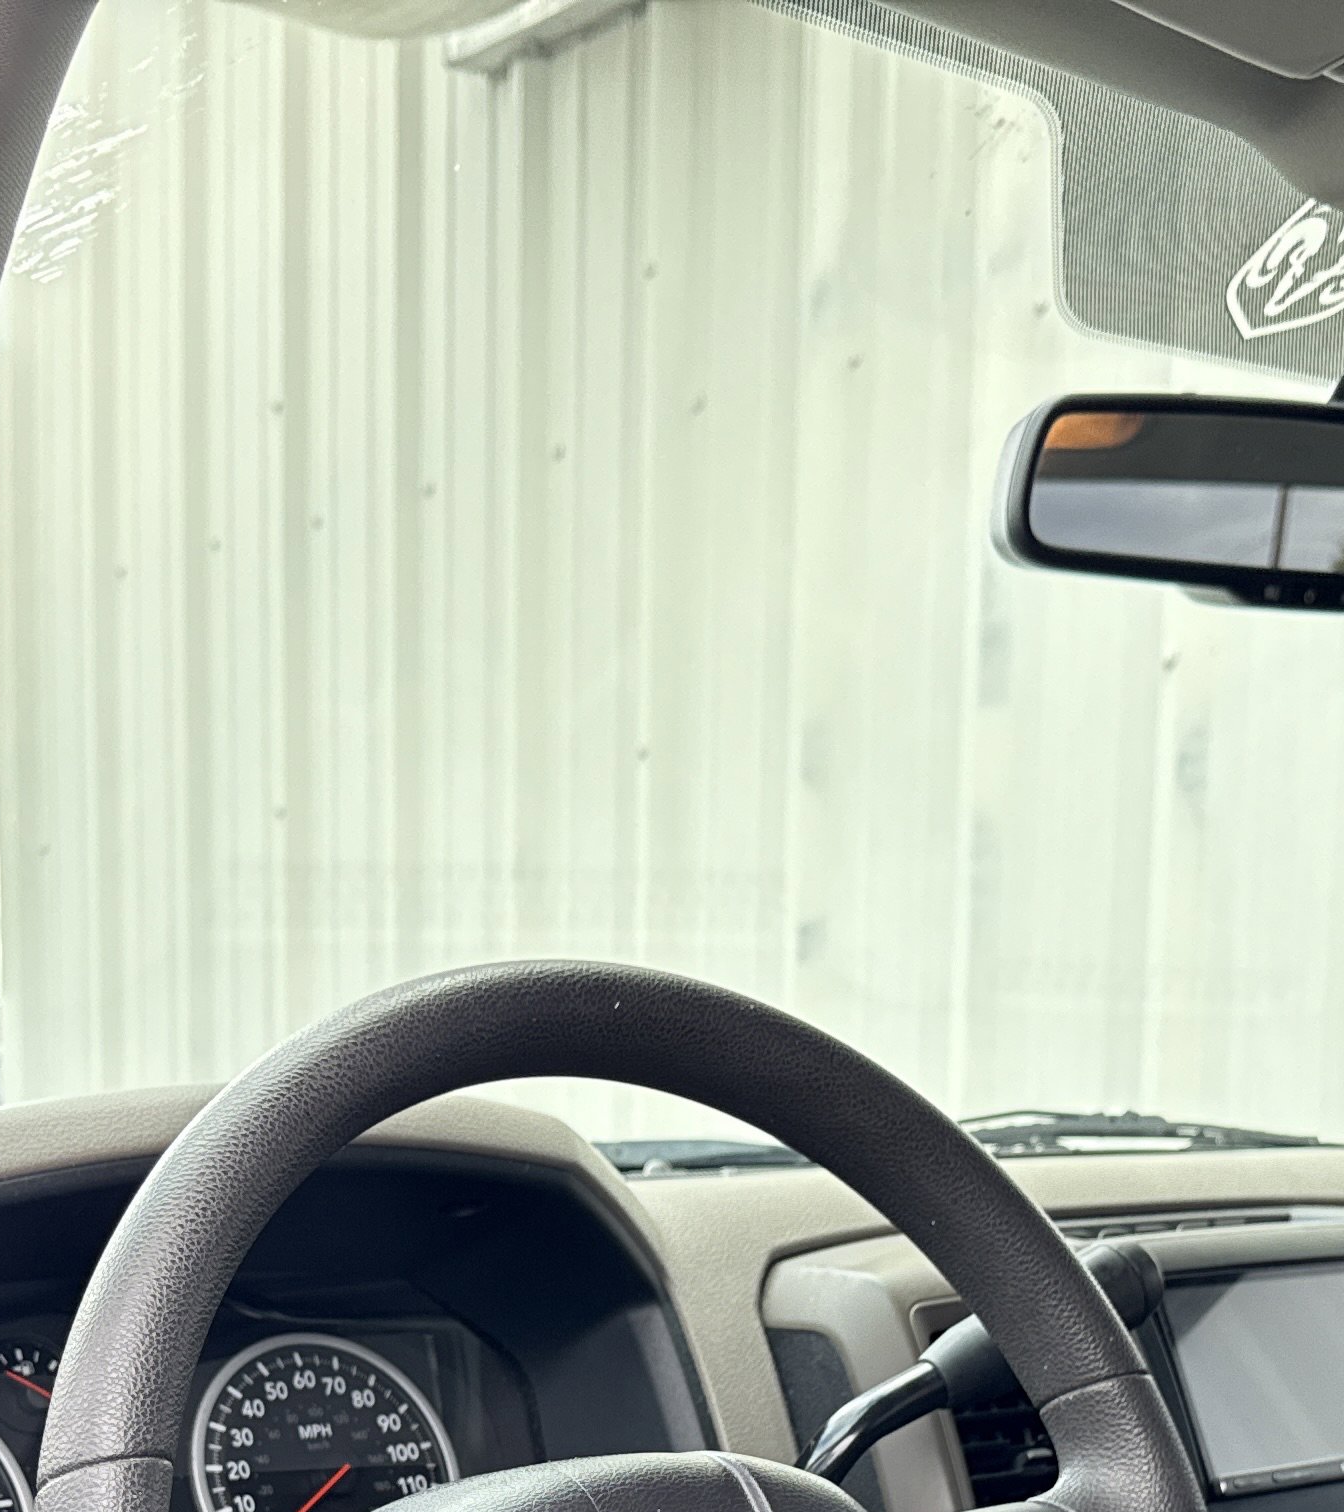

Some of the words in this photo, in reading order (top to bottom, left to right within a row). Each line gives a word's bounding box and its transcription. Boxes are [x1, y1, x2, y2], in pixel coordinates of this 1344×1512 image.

[292, 1370, 316, 1389] 60
[322, 1376, 346, 1396] 70
[264, 1381, 288, 1401] 50
[351, 1389, 376, 1409] 80
[241, 1399, 265, 1419] 40
[297, 1423, 333, 1440] MPH
[376, 1413, 401, 1434] 90
[230, 1428, 254, 1449] 30
[386, 1442, 420, 1463] 100
[226, 1460, 251, 1481] 20
[397, 1474, 428, 1496] 110
